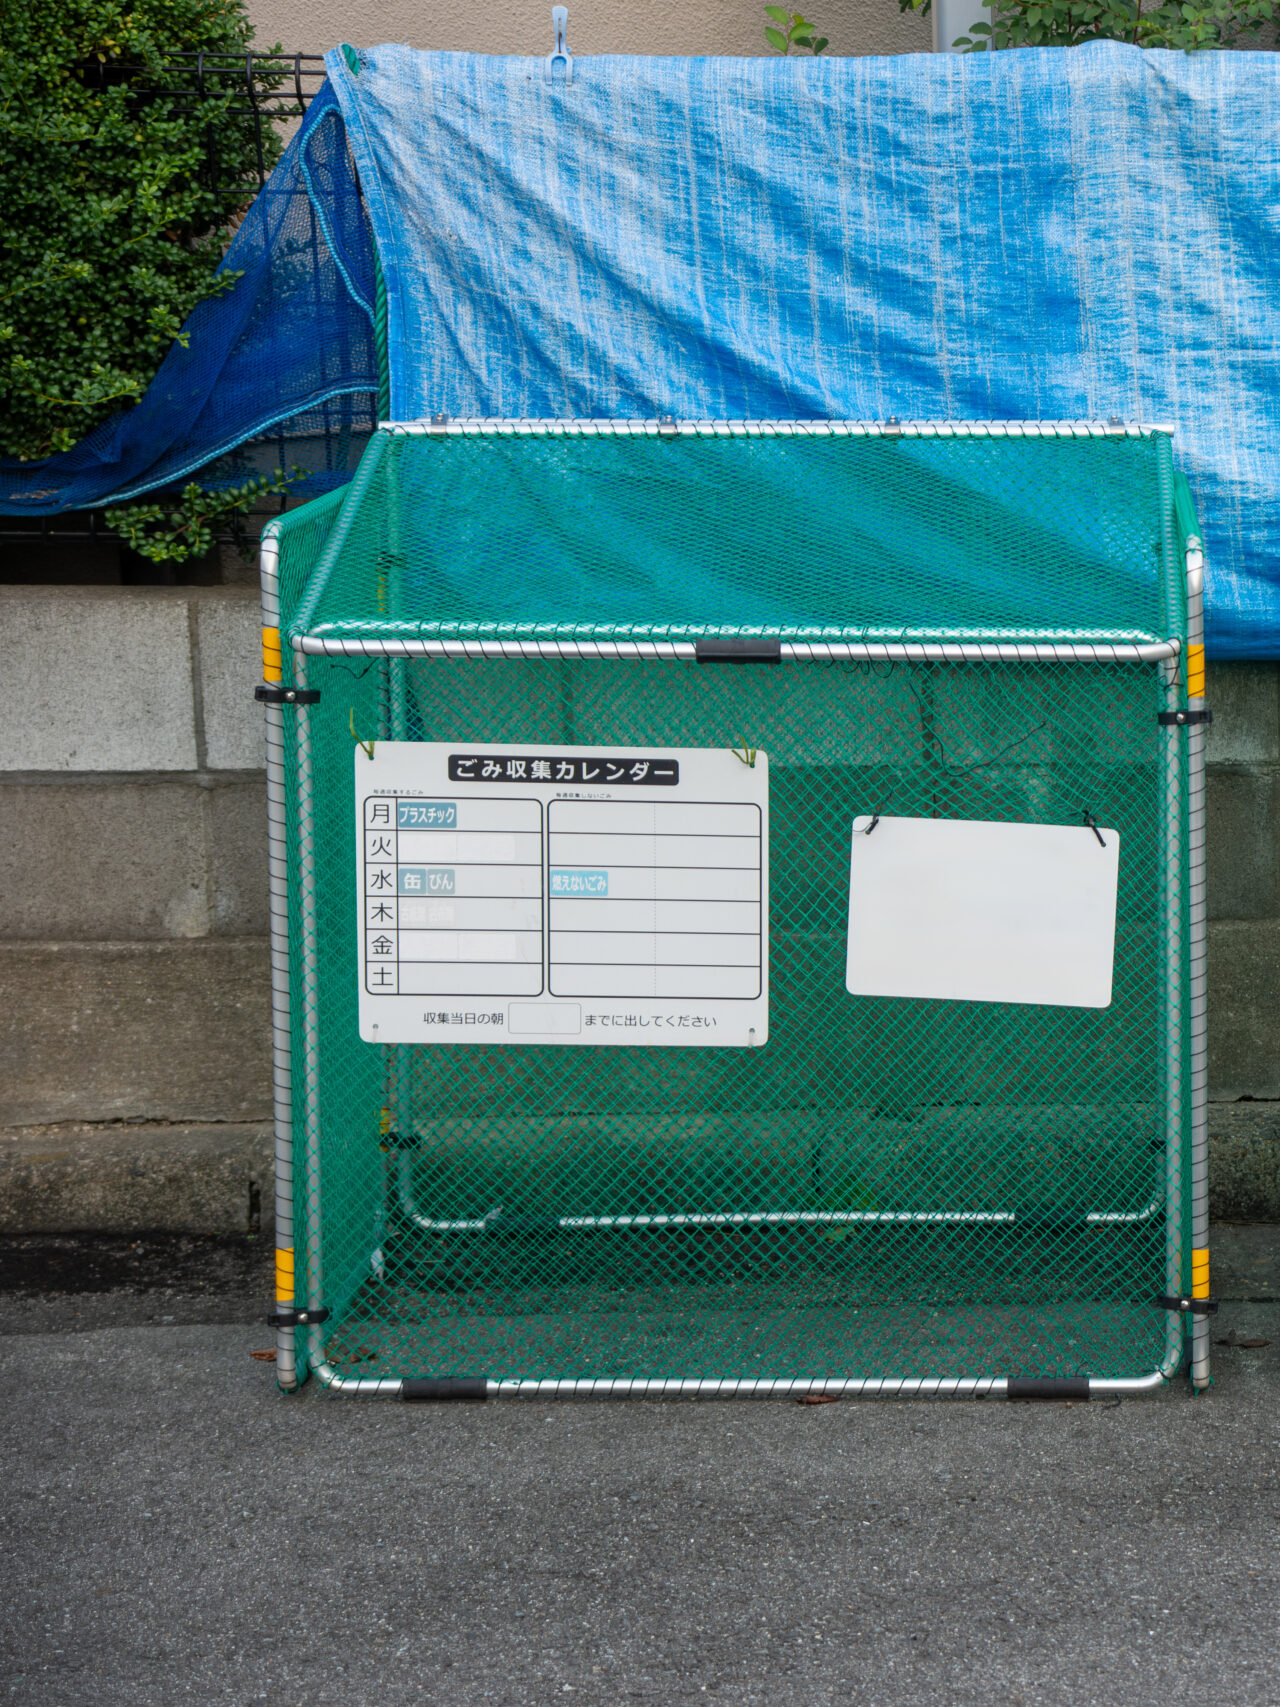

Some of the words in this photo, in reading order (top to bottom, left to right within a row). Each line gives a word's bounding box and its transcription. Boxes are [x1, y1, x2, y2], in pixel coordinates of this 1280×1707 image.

[455, 757, 675, 783] ごみ収集カレンダー
[369, 803, 391, 825] 月
[399, 805, 455, 824] プラスチック
[370, 836, 393, 858] 火
[370, 869, 394, 890] 水
[403, 873, 421, 891] 缶
[429, 872, 454, 891] びん
[551, 874, 608, 893] 燃えないごみ
[371, 902, 395, 923] 木
[371, 935, 394, 956] 金
[372, 967, 394, 987] 土
[423, 1011, 505, 1027] 収集当日の朝
[584, 1013, 718, 1029] までに出してください
